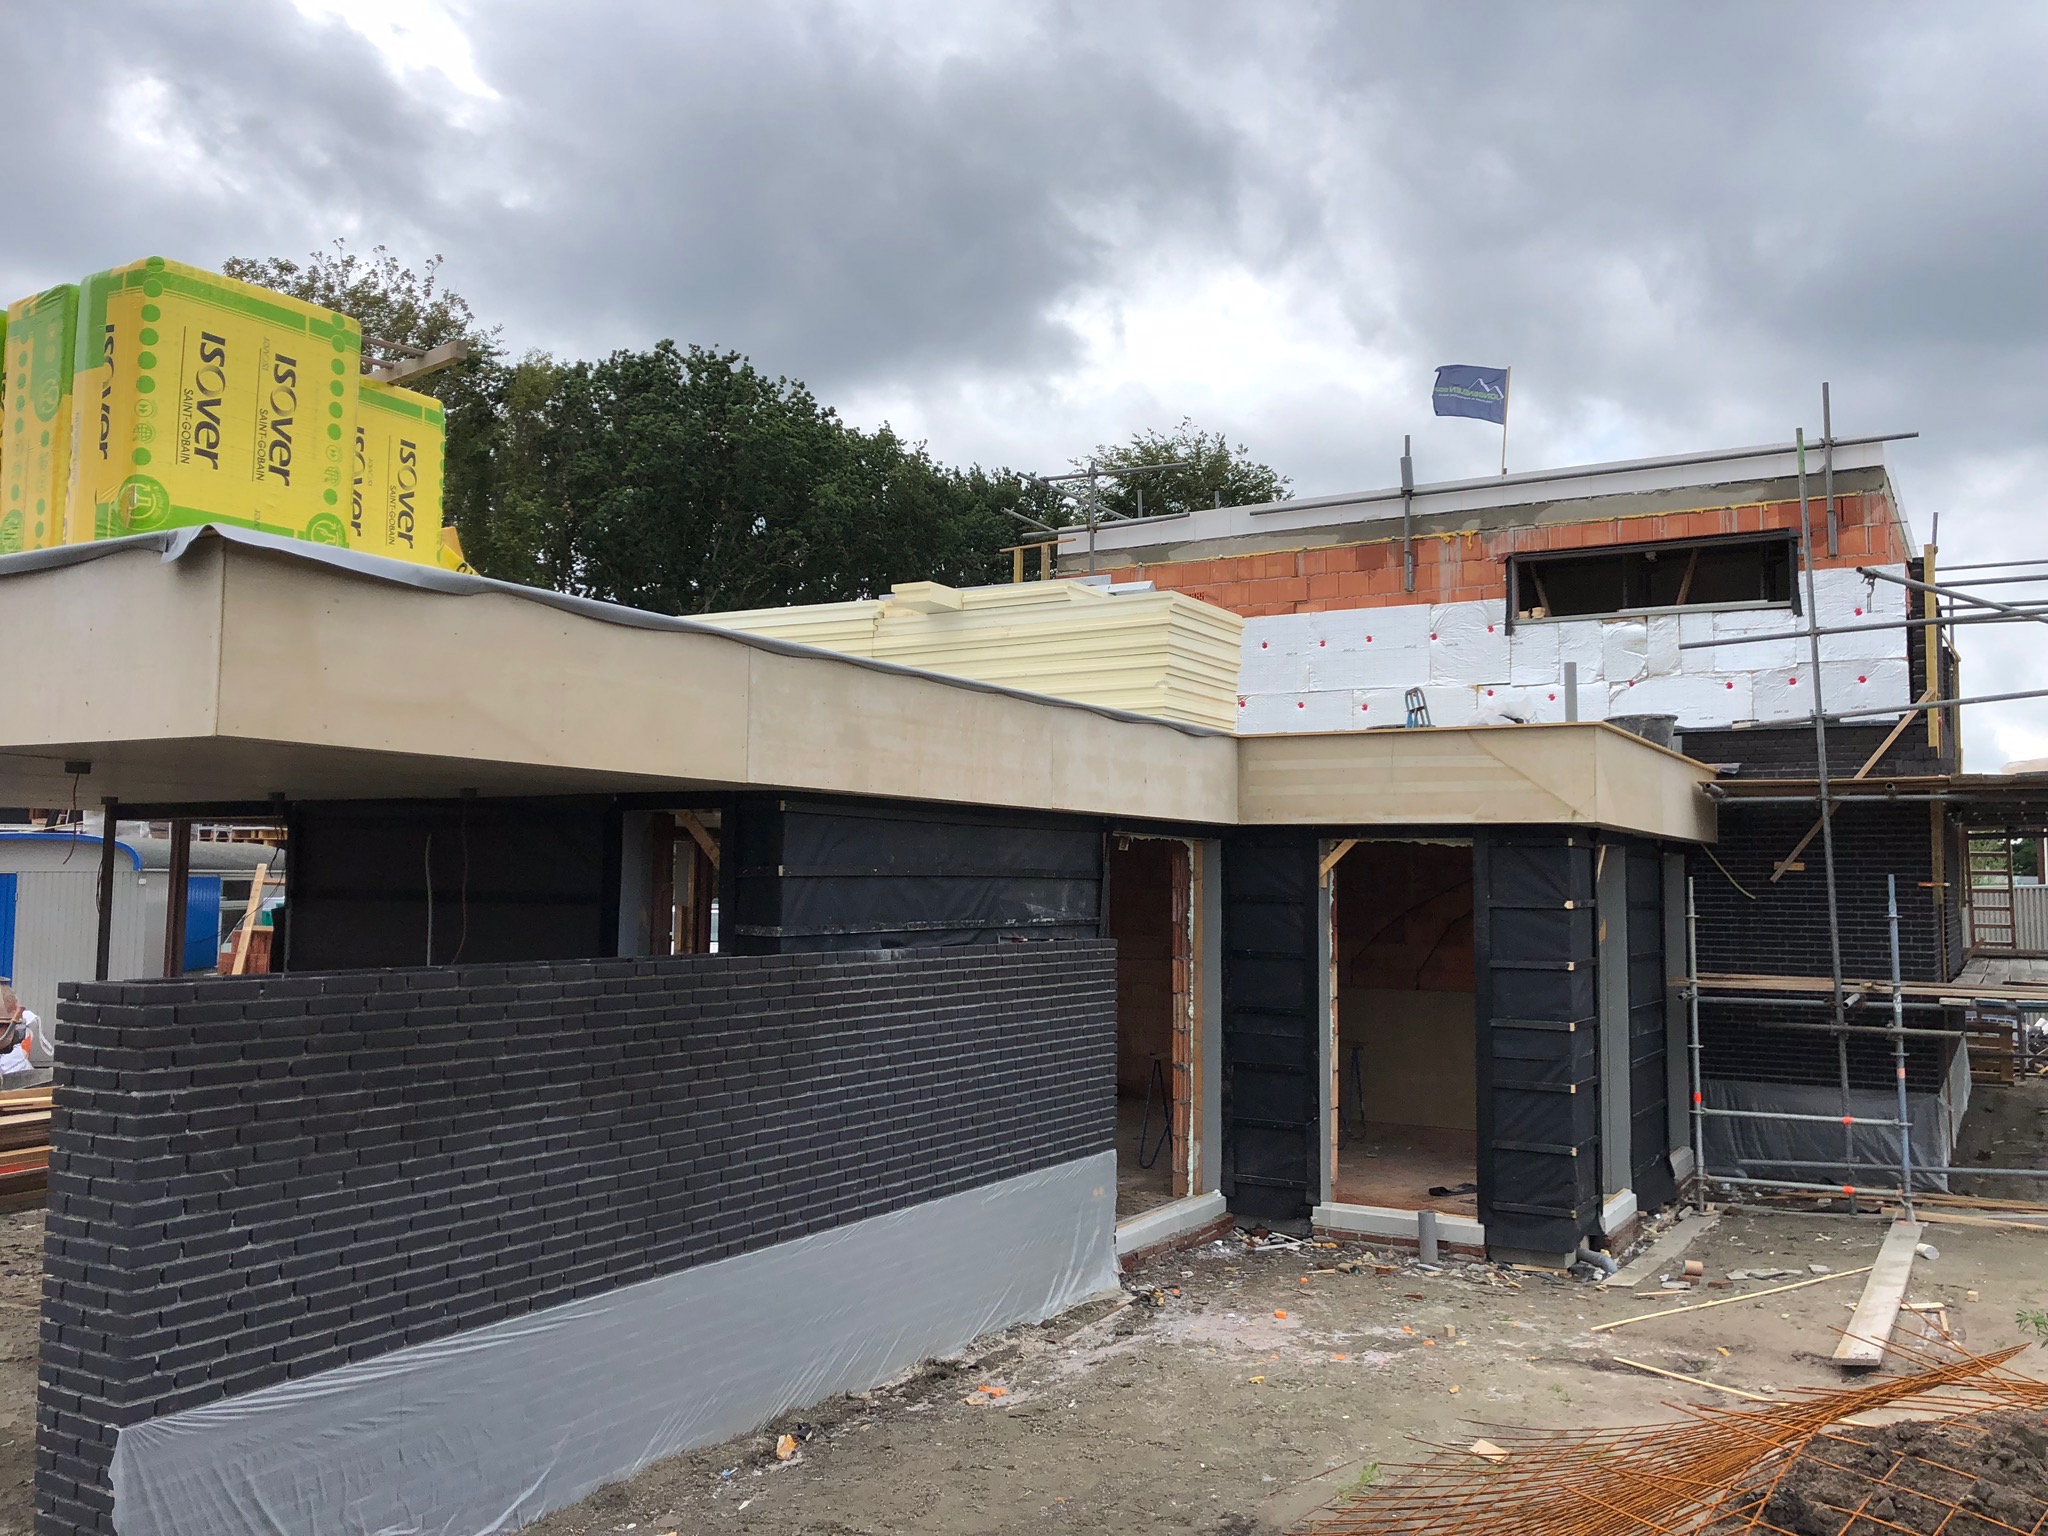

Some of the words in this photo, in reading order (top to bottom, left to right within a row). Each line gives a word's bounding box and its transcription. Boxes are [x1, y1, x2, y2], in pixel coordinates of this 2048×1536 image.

[180, 388, 194, 465] SAINT-GOBAIN
[256, 408, 269, 482] SAINT-GOBAIN
[388, 485, 397, 545] SAINT-GOBAIN
